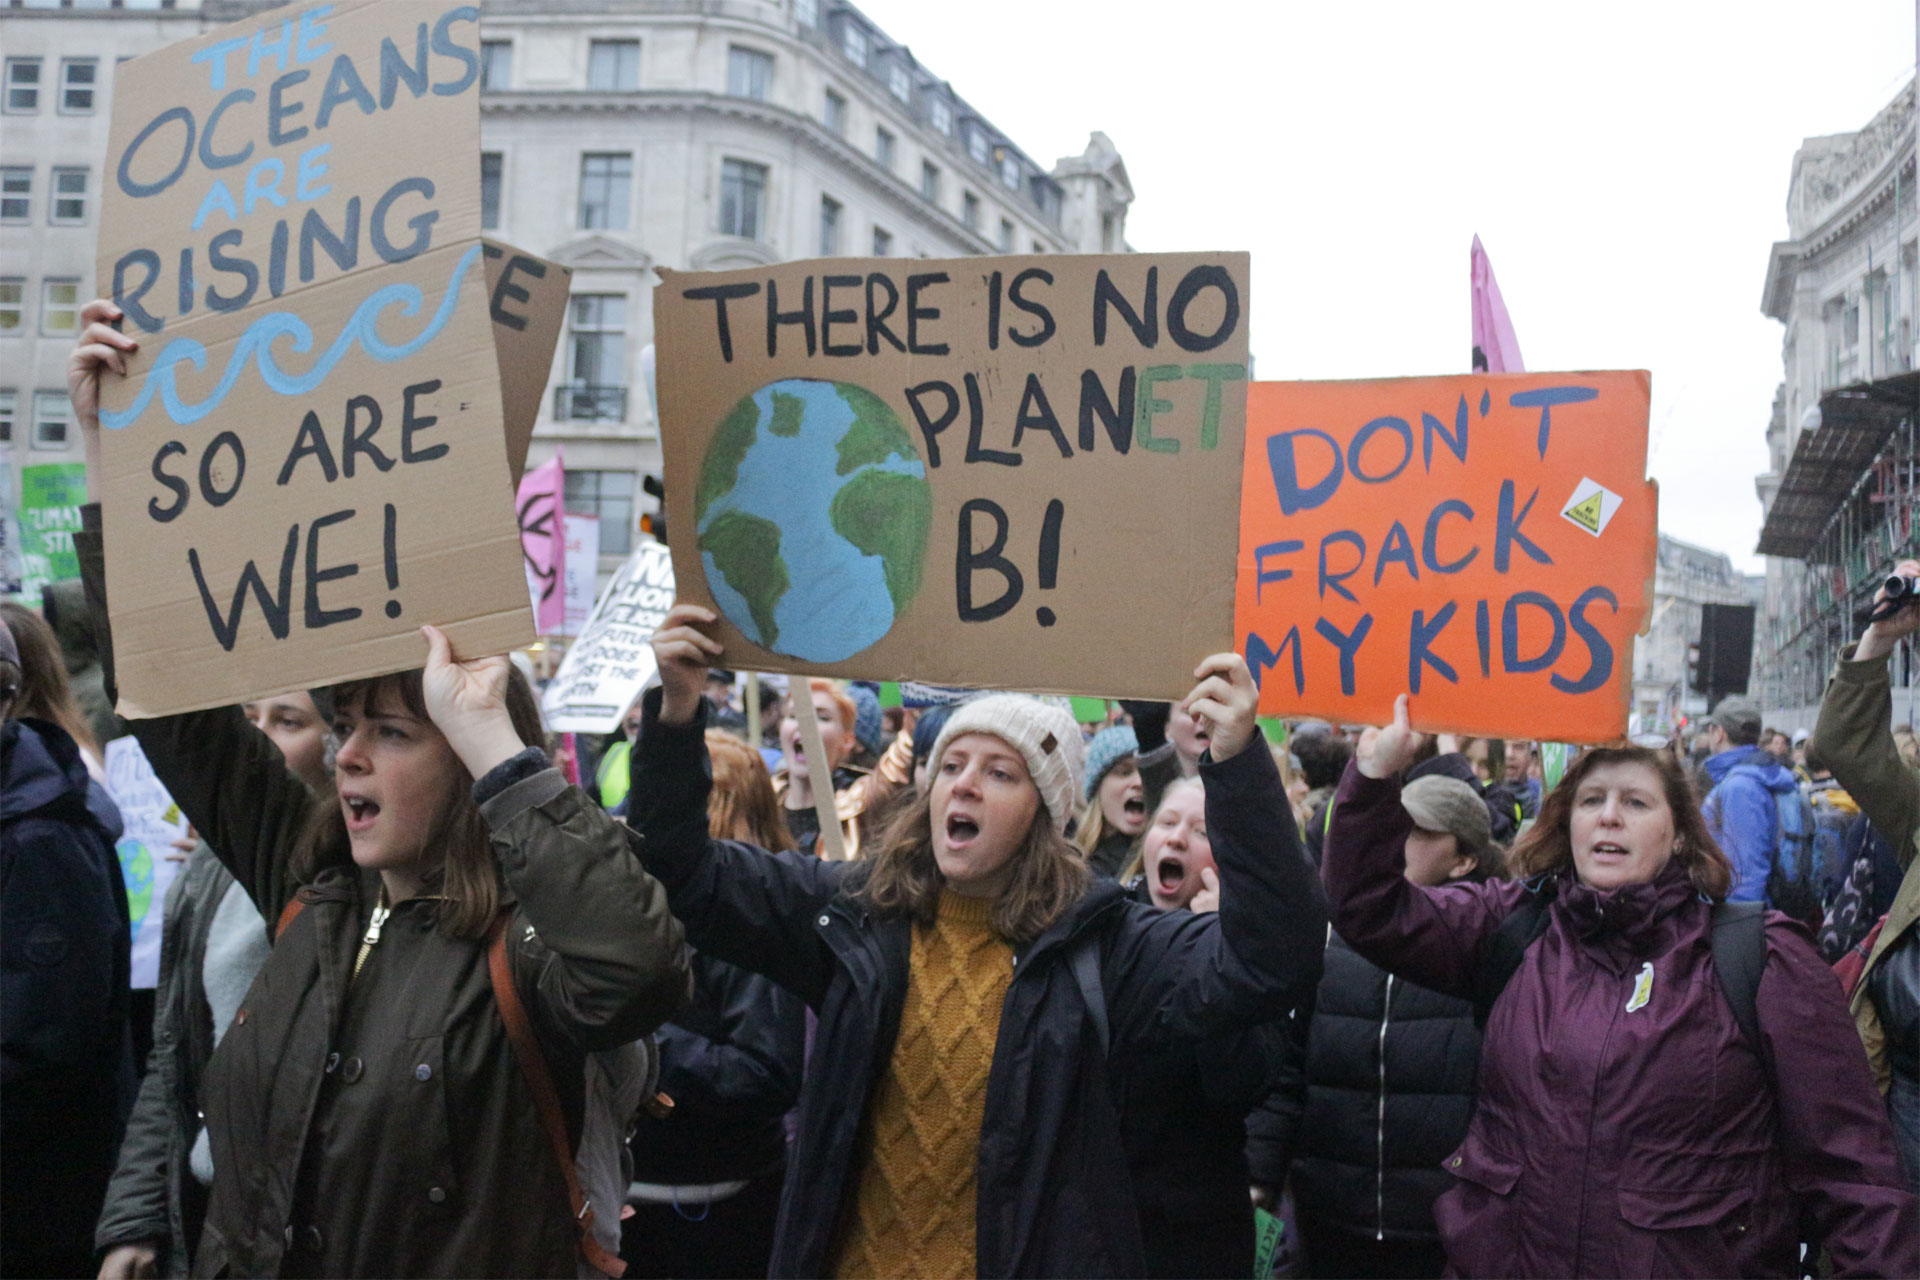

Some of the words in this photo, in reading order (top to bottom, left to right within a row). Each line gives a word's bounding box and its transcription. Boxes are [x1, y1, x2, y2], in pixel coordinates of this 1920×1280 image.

[115, 4, 480, 198] OCEANS
[190, 2, 337, 92] THE
[190, 141, 334, 232] ARE
[111, 175, 441, 337] RISING
[681, 271, 951, 364] THERE
[988, 267, 1057, 351] IS
[1093, 264, 1240, 353] NO
[148, 431, 246, 523] SO
[276, 379, 451, 486] ARE
[904, 362, 1246, 470] PLANET
[1266, 385, 1600, 517] DON'T
[188, 503, 402, 652] WE!
[955, 498, 1065, 628] B!
[1254, 479, 1555, 606] FRACK
[1244, 613, 1374, 697] MY
[1408, 585, 1619, 695] KIDS
